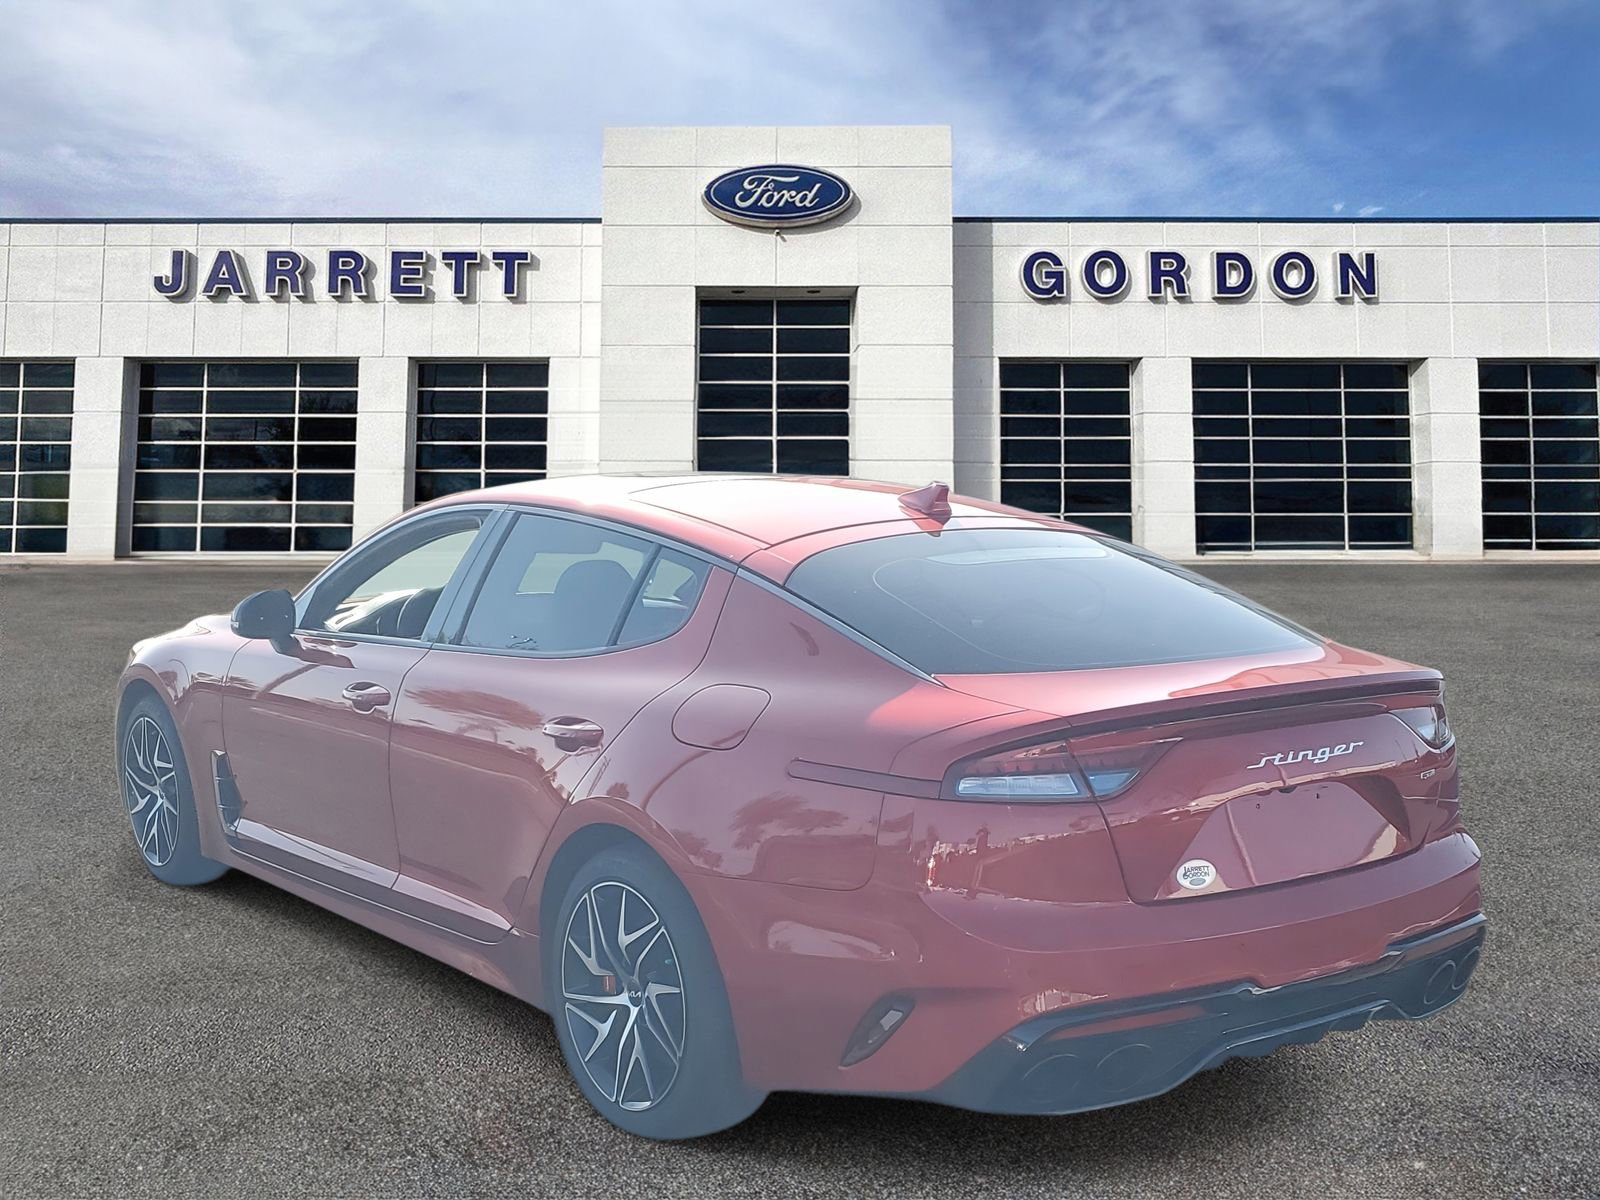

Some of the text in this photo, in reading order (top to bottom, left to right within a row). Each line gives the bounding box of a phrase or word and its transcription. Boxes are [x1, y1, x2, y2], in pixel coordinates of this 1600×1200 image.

[734, 174, 822, 208] Ford
[153, 248, 532, 298] JARRETT
[1020, 249, 1380, 300] GORDON
[1183, 870, 1210, 880] GORDON
[1184, 865, 1210, 873] JARRETT
